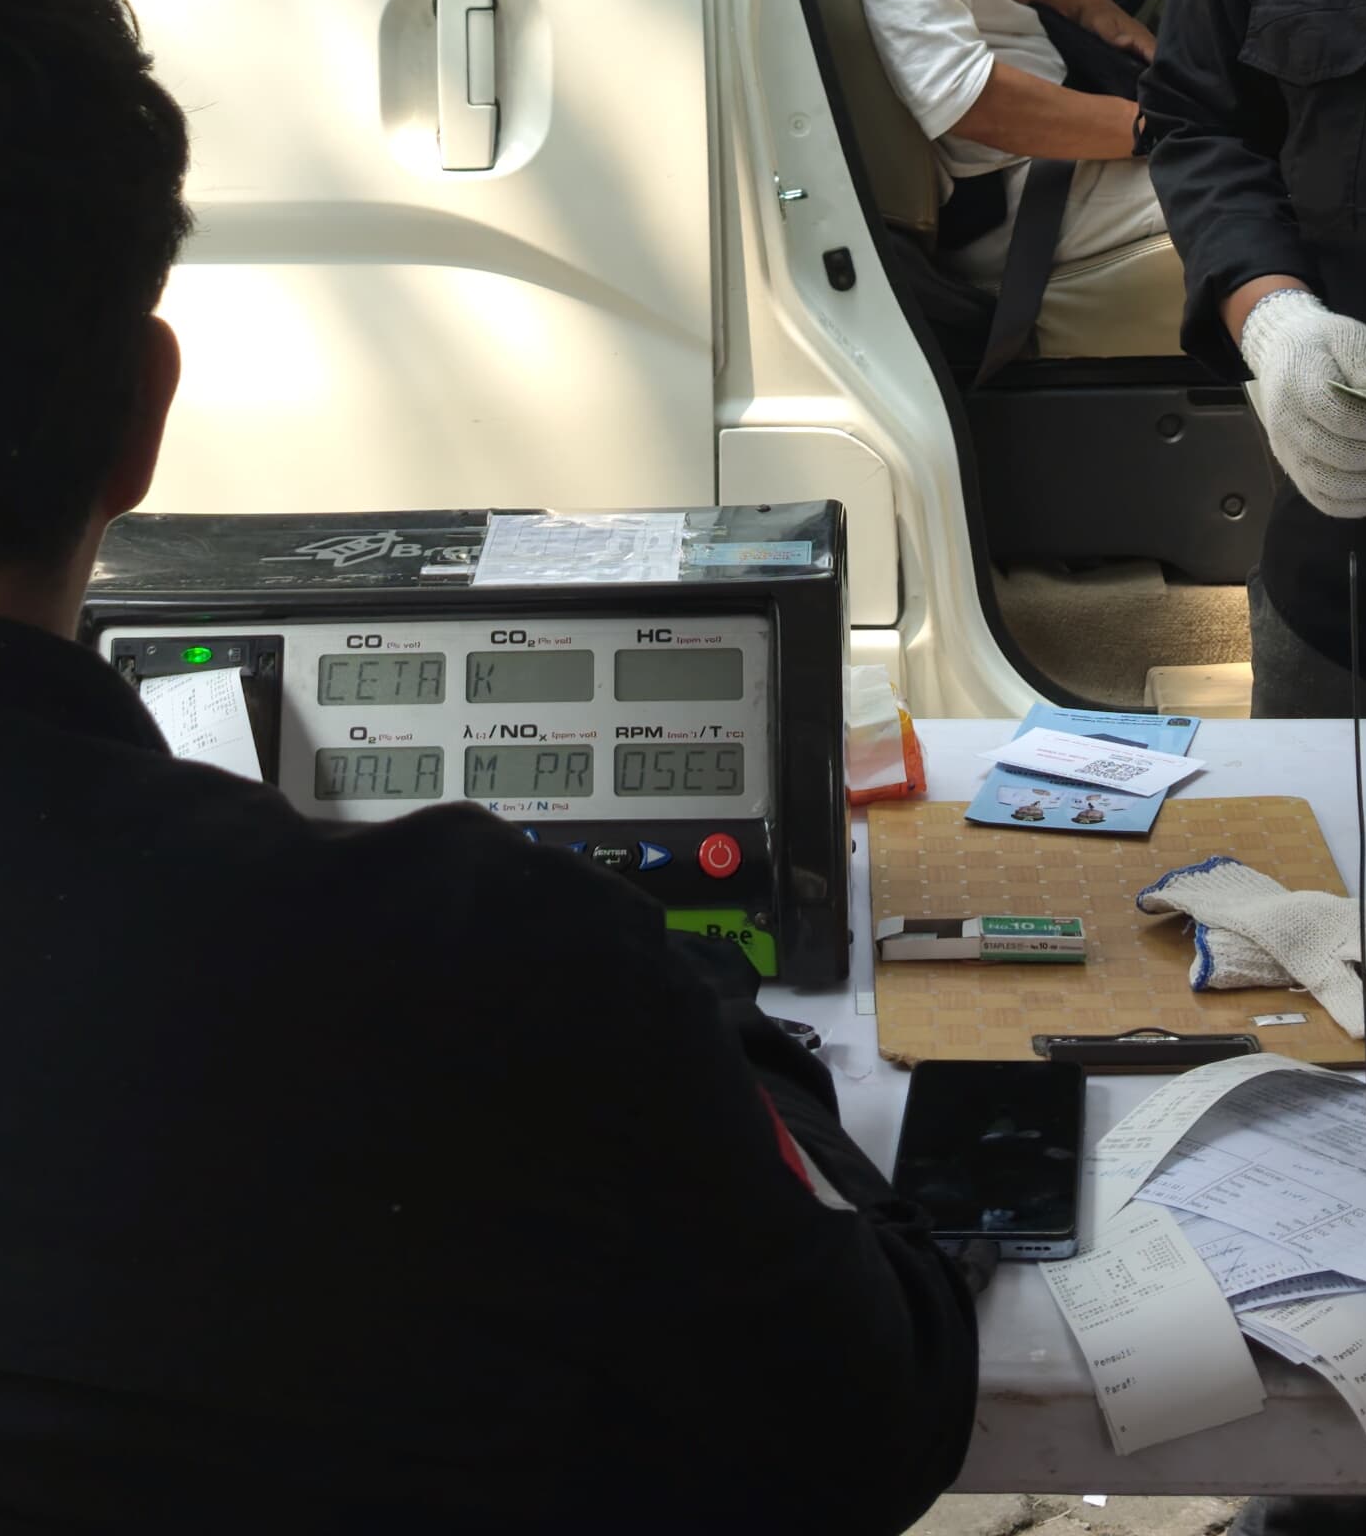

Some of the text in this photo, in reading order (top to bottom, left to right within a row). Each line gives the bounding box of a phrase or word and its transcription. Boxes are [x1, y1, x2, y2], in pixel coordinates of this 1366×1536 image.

[347, 635, 382, 648] CO
[637, 629, 672, 643] HC
[325, 661, 494, 700] CETA K
[616, 727, 663, 738] RPM
[472, 755, 498, 791] M
[534, 752, 590, 790] PR
